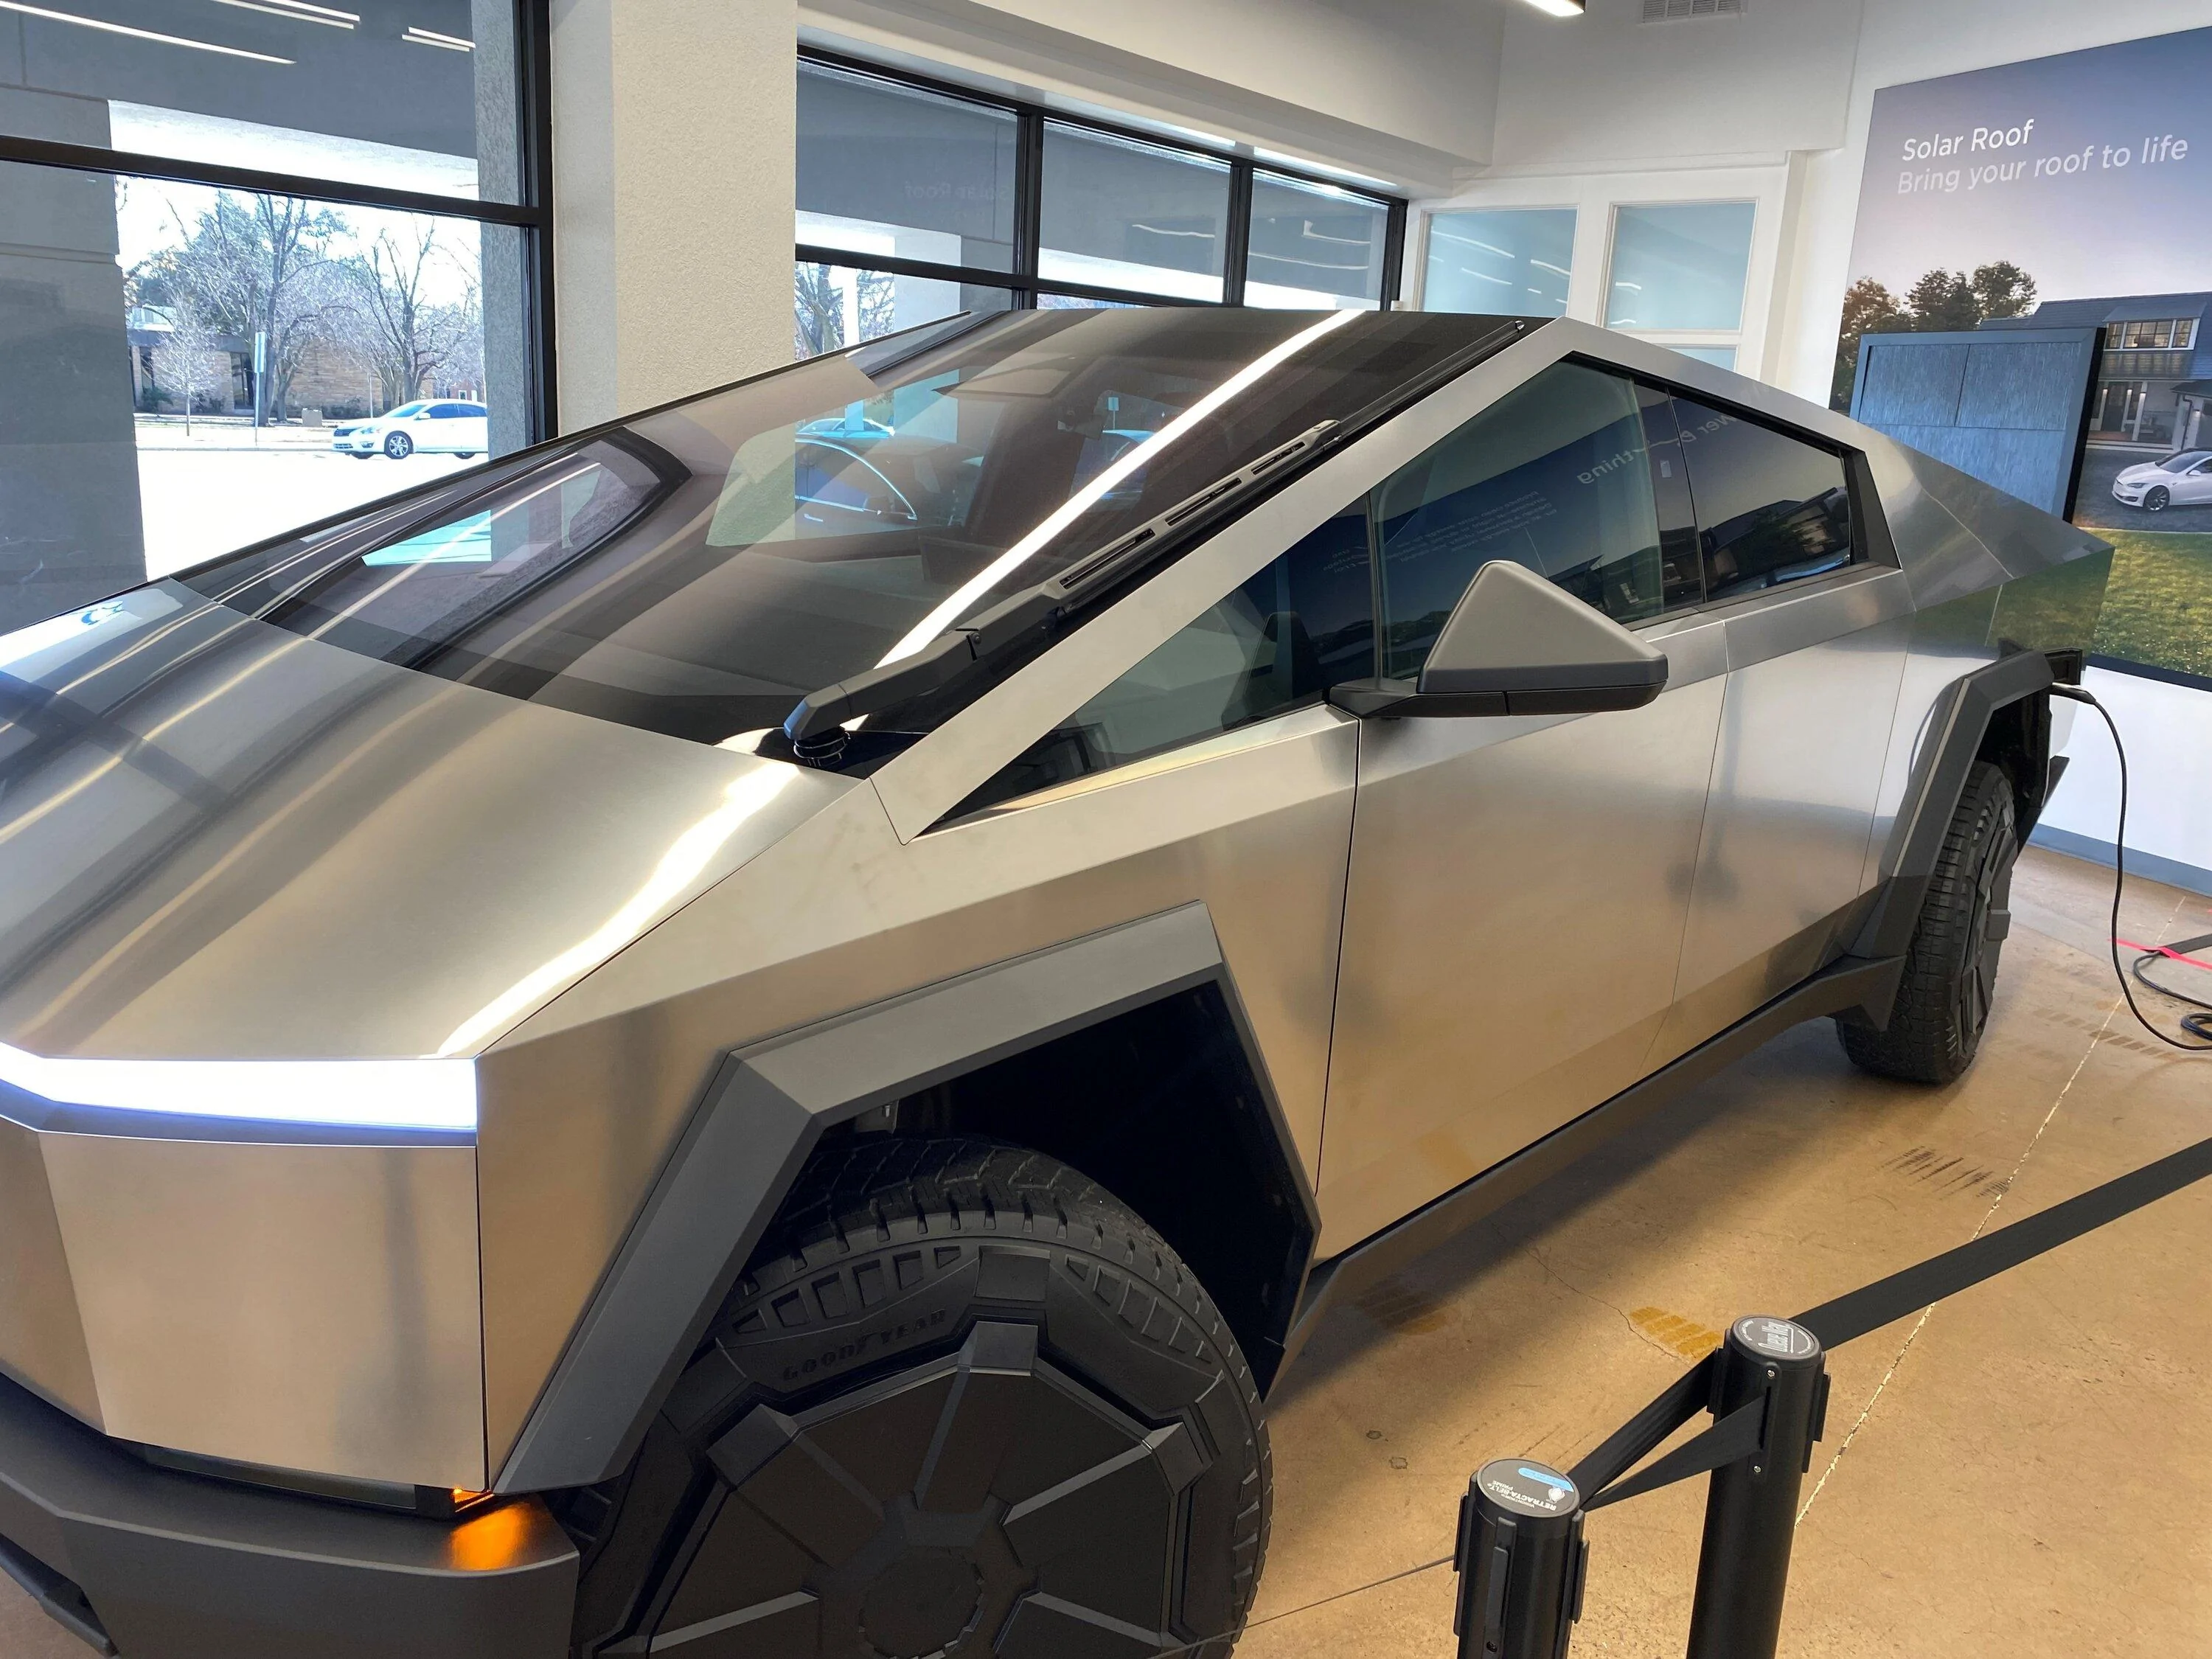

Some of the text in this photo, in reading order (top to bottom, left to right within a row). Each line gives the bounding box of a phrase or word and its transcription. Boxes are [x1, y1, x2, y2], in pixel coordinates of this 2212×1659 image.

[1897, 133, 2188, 194] Bring your roof to life
[1902, 119, 2034, 161] Solar Roof
[783, 1309, 945, 1380] GOODYEAR
